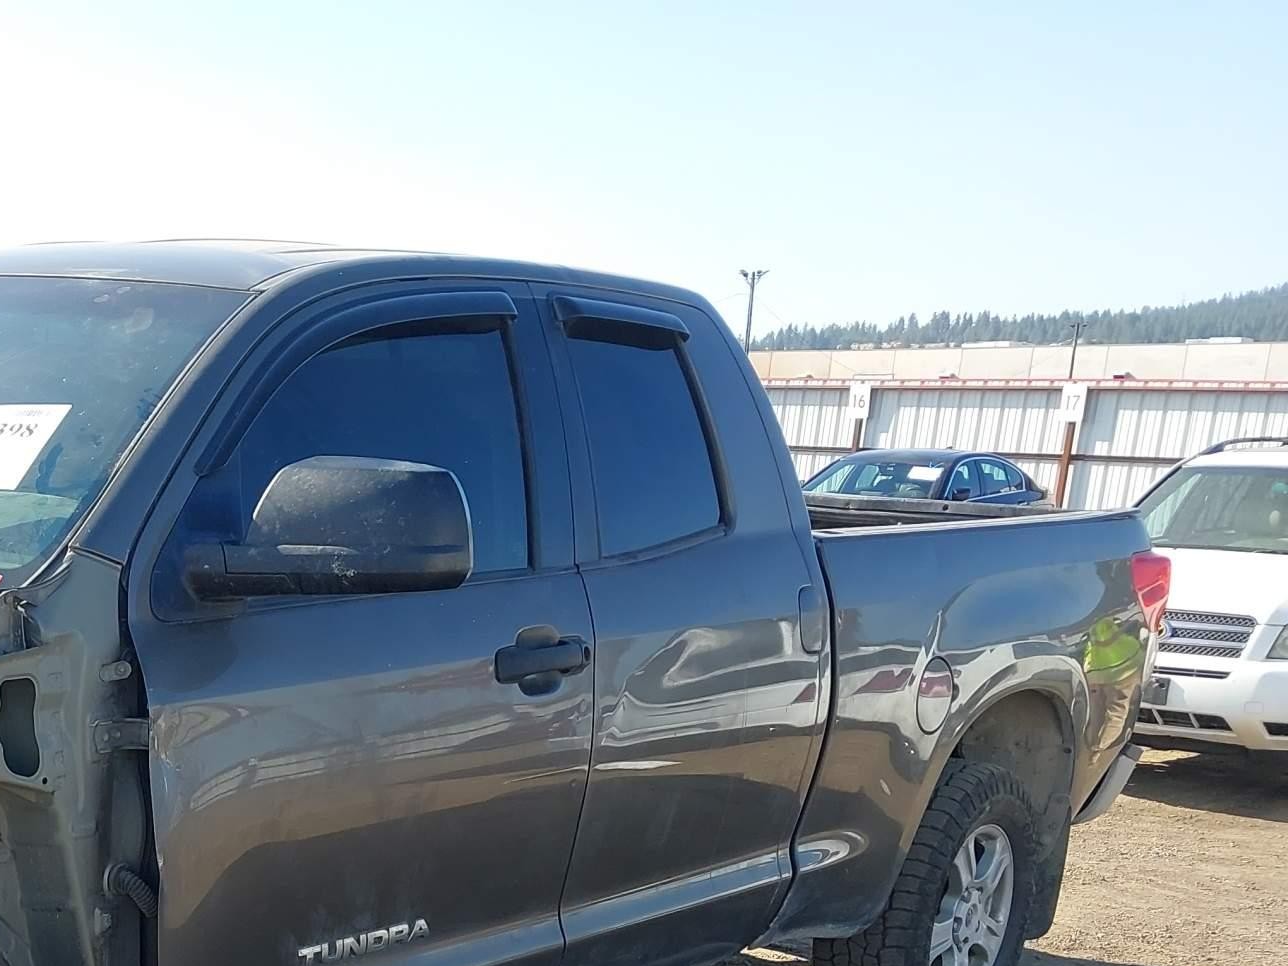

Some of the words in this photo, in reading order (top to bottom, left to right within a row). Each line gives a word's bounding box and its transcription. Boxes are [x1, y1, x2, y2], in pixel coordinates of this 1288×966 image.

[852, 394, 866, 409] 16
[1065, 394, 1081, 411] 17
[297, 917, 430, 966] TUNDRA
